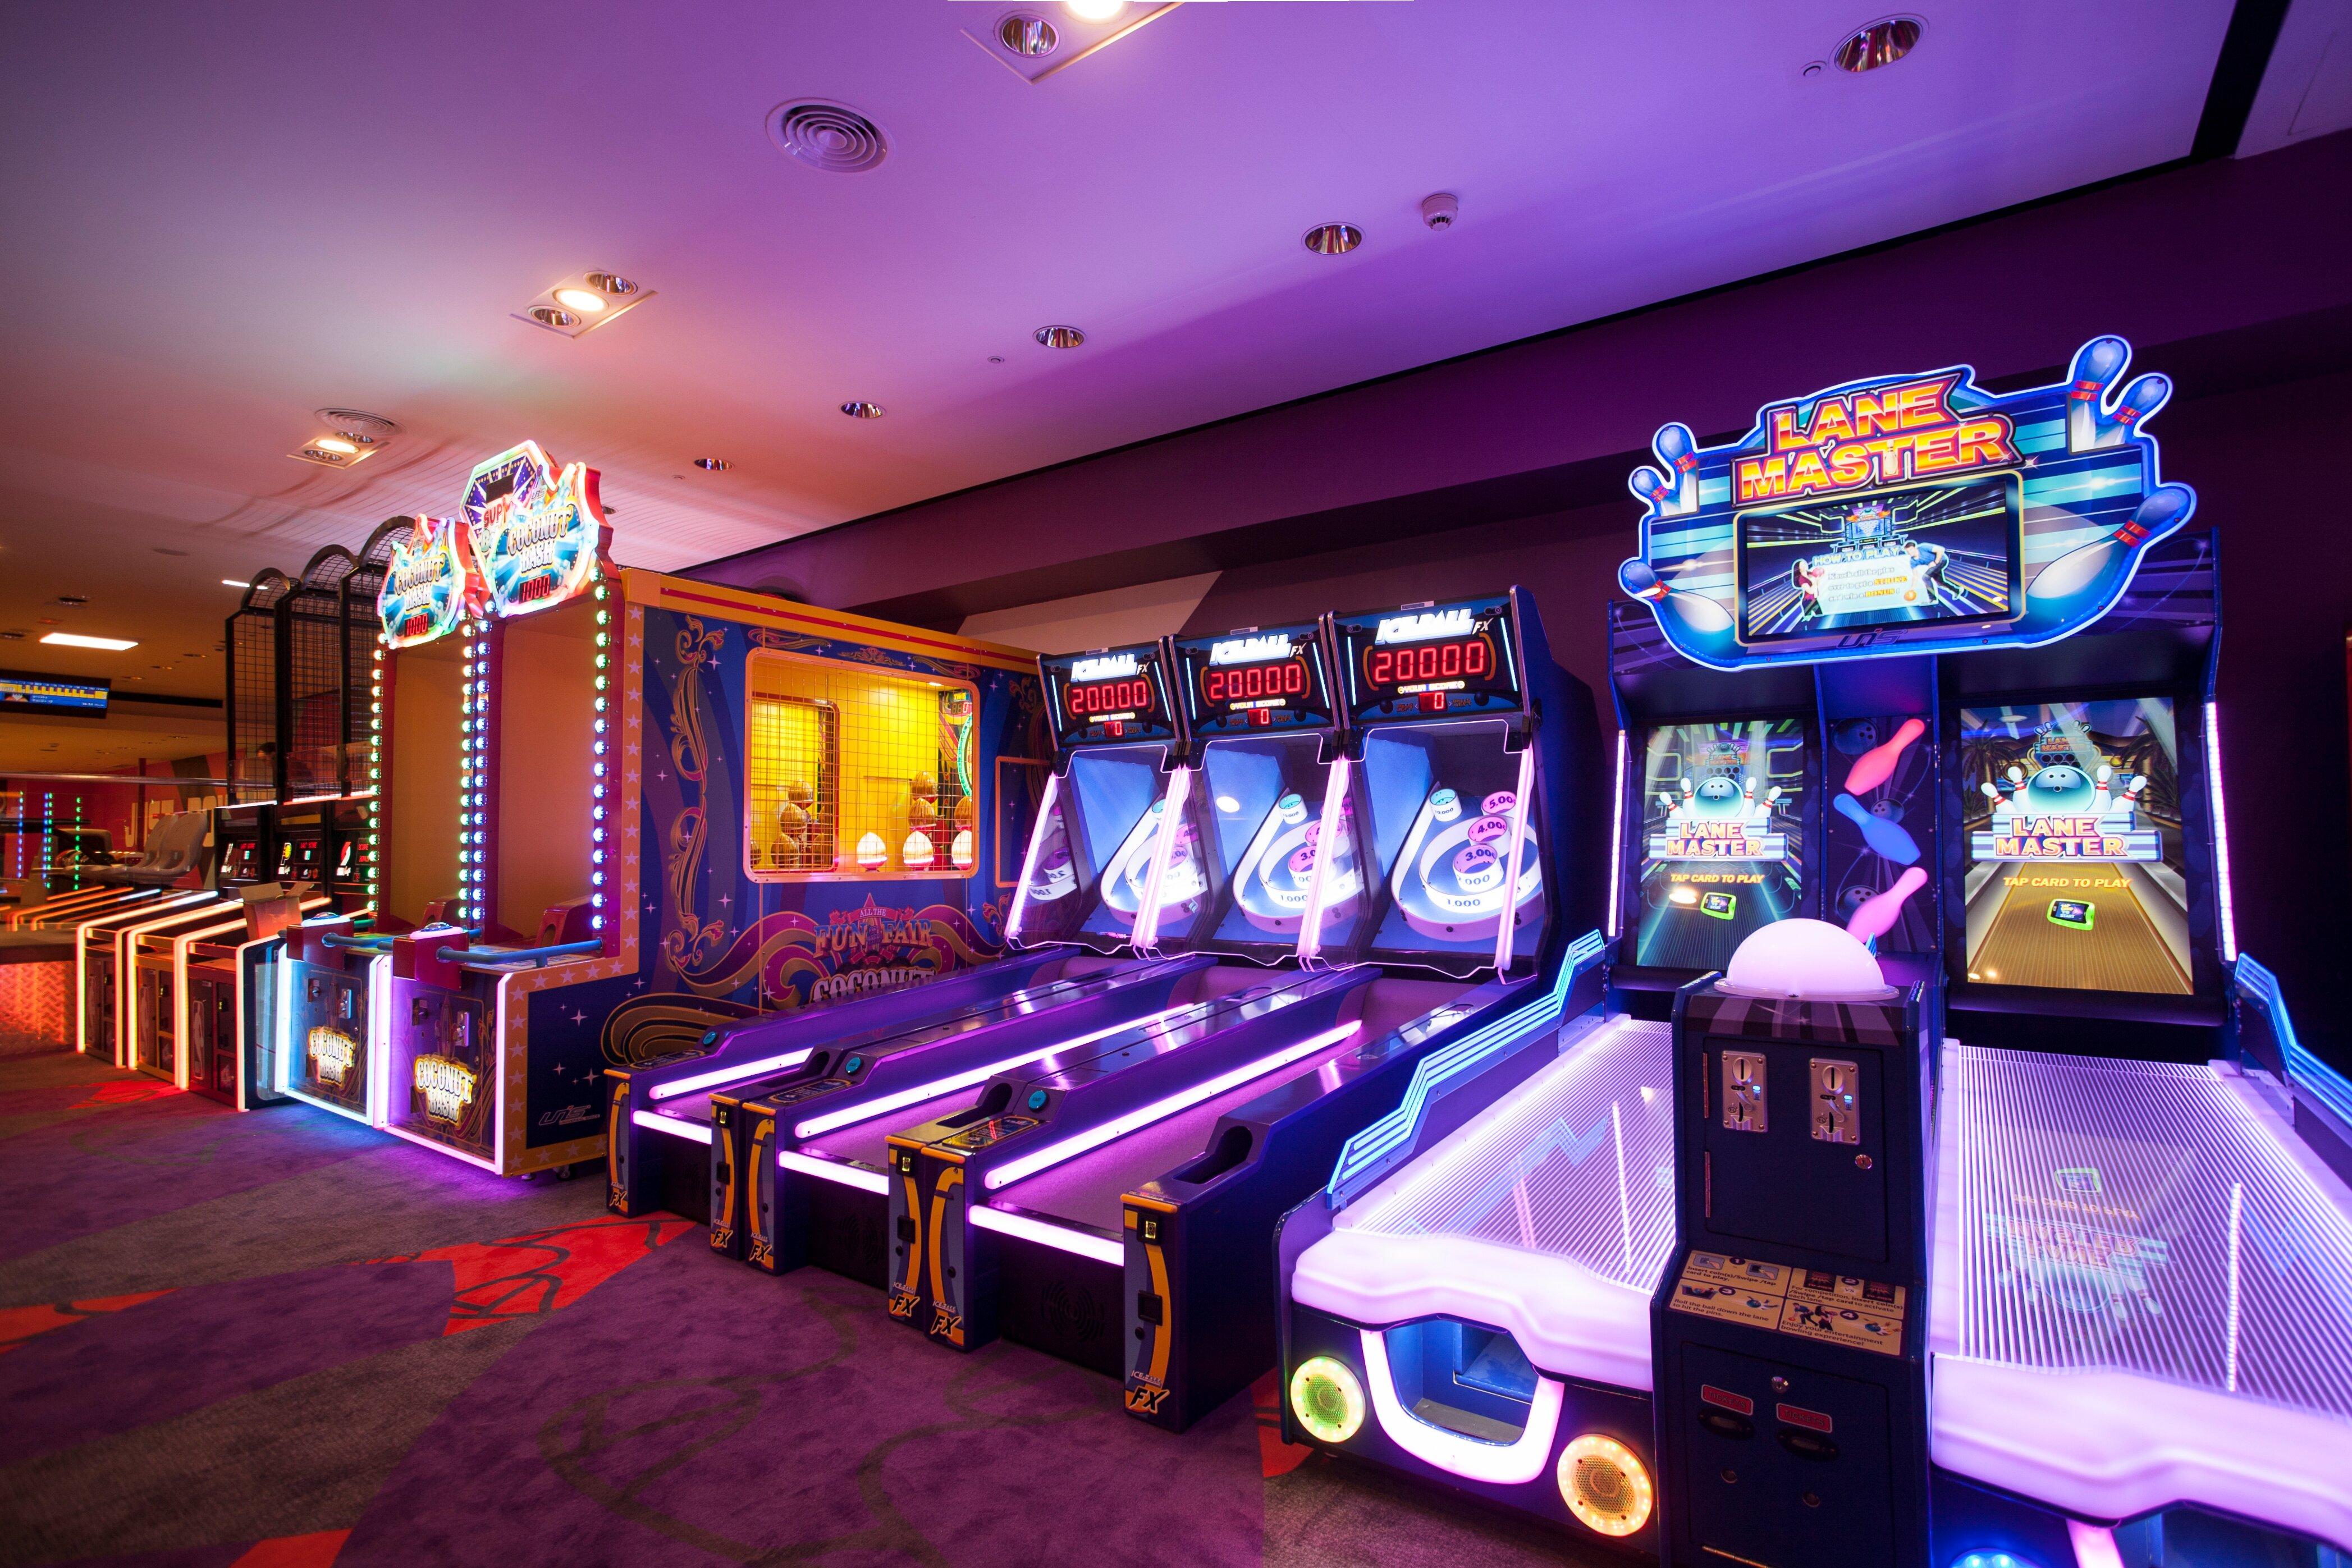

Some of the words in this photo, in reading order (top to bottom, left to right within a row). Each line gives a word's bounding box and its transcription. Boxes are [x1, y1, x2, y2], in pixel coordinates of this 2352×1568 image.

[1776, 382, 1947, 451] LANE
[1740, 421, 2010, 500] MASTER
[507, 507, 571, 556] COCONUT
[1814, 553, 1843, 565] HOW
[1846, 551, 1863, 562] TO
[1866, 547, 1900, 559] PLAY
[395, 558, 443, 596] COCONUT
[523, 574, 550, 602] 1000
[407, 614, 428, 636] 1000
[1472, 617, 1494, 635] FX
[1290, 642, 1307, 658] FX
[1136, 662, 1150, 675] FX
[1375, 642, 1484, 681] 20000
[1210, 664, 1301, 699] 20000
[1072, 681, 1147, 713] 20000
[1434, 693, 1444, 709] 0
[1261, 709, 1269, 724] 0
[1115, 721, 1122, 735] 0
[1681, 822, 1744, 839] LANE
[2012, 818, 2098, 836] LANE
[1667, 840, 1763, 856] MASTER
[1996, 837, 2129, 856] MASTER
[1691, 874, 1719, 883] CARD
[1722, 874, 1736, 883] TO
[1737, 875, 1765, 883] PLAY
[2003, 877, 2029, 887] TAP
[2031, 878, 2070, 887] CARD
[2072, 878, 2092, 887] TO
[2094, 878, 2131, 888] PLAY
[860, 909, 872, 918] ALL
[873, 908, 887, 916] THE
[813, 922, 868, 959] FUN
[881, 919, 933, 948] FAIR
[310, 1030, 354, 1066] COCONUT
[417, 1060, 474, 1103] COCONUT
[429, 1089, 460, 1121] BASH
[610, 1190, 627, 1207] FX
[712, 1230, 733, 1248] FX
[749, 1243, 772, 1261] FX
[891, 1294, 920, 1317] FX
[1808, 1288, 1850, 1300] competition,
[1877, 1301, 1903, 1310] coin(s)
[1864, 1303, 1895, 1313] activate
[1702, 1303, 1715, 1312] ball
[1717, 1306, 1737, 1315] down
[930, 1314, 962, 1337] FX
[1781, 1325, 1812, 1336] bowling
[1782, 1321, 1803, 1329] Enjoy
[1824, 1329, 1883, 1345] entertainment
[1128, 1385, 1170, 1414] FX
[1709, 1391, 1746, 1409] TICKETS
[1784, 1409, 1824, 1426] TICKETS
